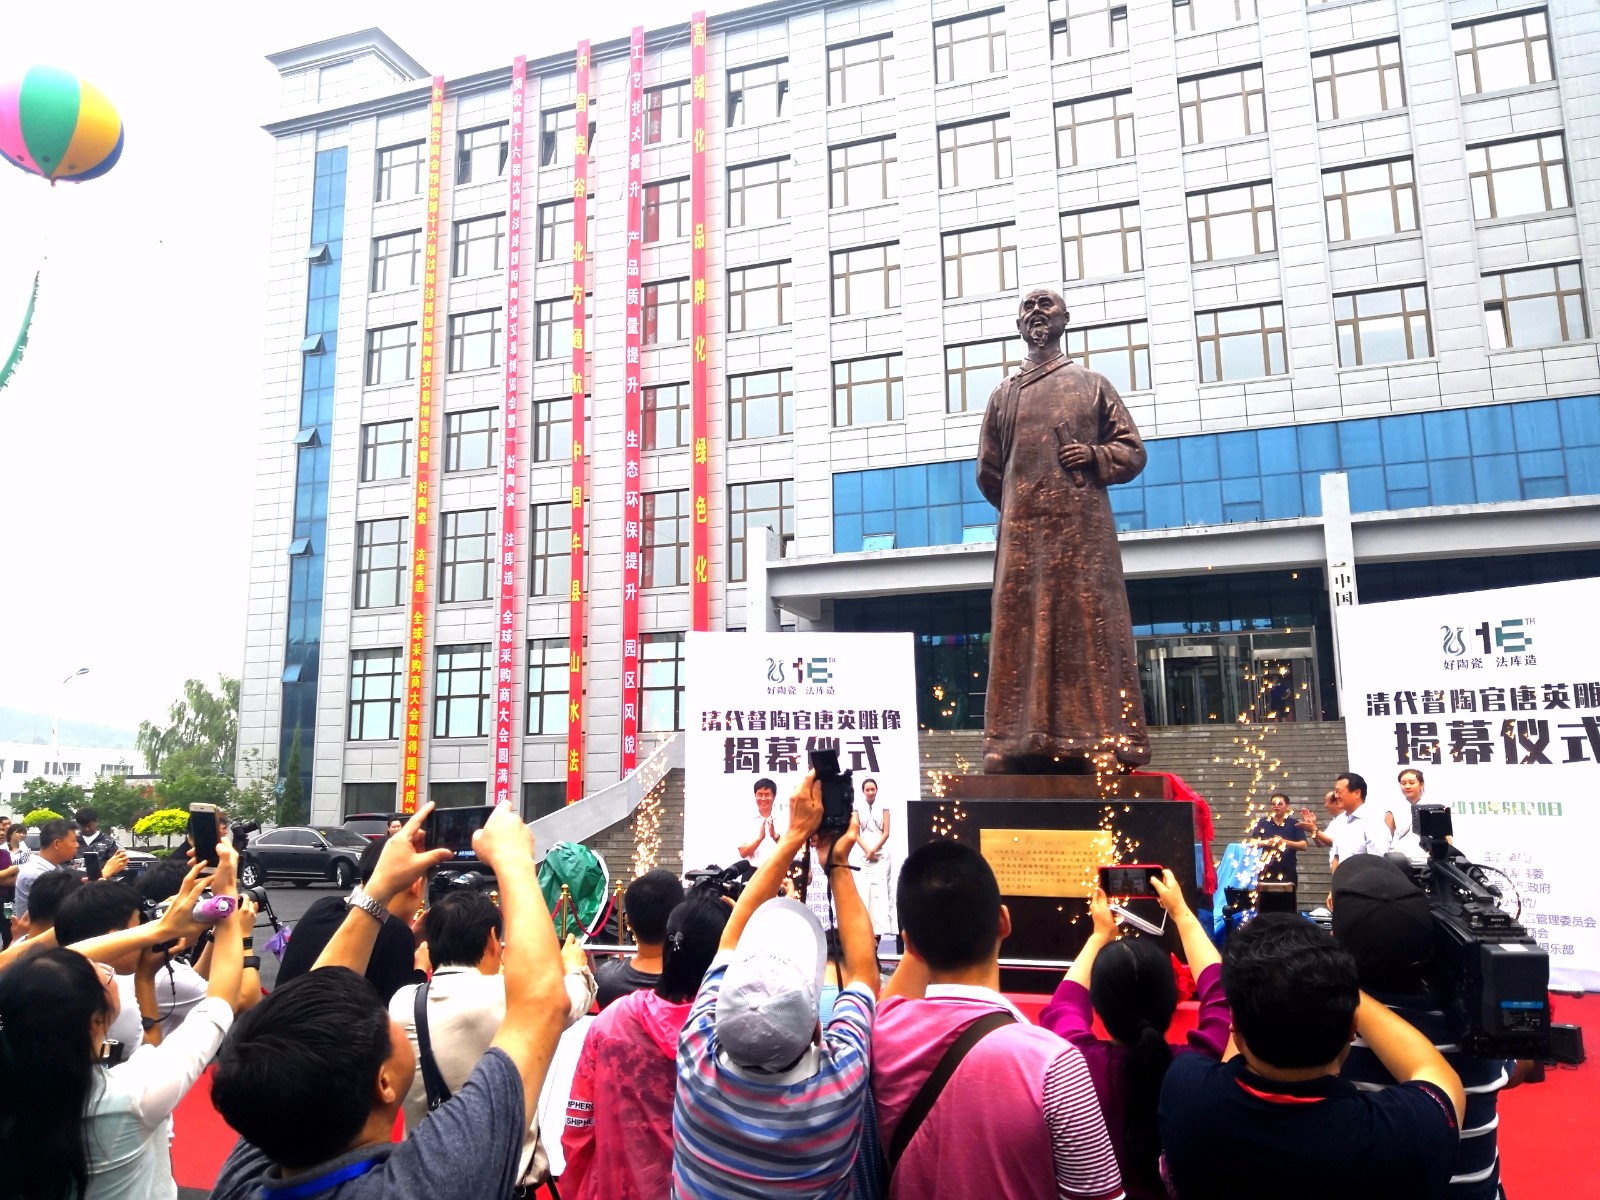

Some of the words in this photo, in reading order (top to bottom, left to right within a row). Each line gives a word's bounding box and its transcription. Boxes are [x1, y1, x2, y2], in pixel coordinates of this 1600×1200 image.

[629, 45, 642, 197] 工艺技术提升
[693, 21, 705, 153] 高端化
[572, 241, 584, 394] 北方通航
[627, 230, 640, 394] 产品质量提升
[693, 224, 706, 361] 品牌化
[625, 429, 639, 601] 生态环保提升
[694, 438, 708, 583] 绿色化
[702, 709, 901, 732] 清代督陶官唐英雕像
[767, 686, 797, 696] 好陶瓷
[805, 686, 836, 696] 法库造
[1443, 658, 1484, 670] 好陶瓷
[1496, 654, 1538, 668] 法库造
[1394, 716, 1600, 766] 揭幕仪式
